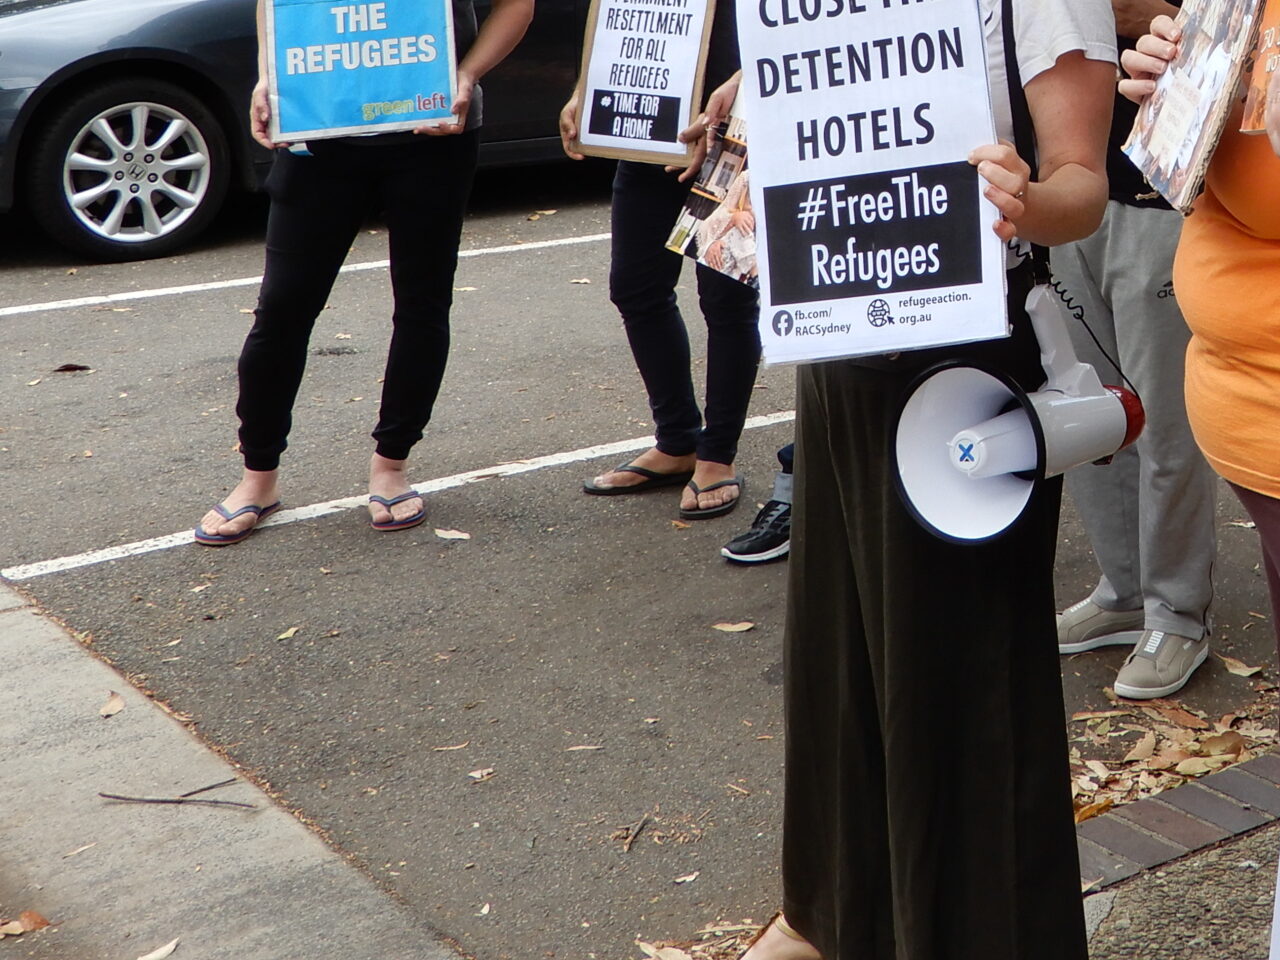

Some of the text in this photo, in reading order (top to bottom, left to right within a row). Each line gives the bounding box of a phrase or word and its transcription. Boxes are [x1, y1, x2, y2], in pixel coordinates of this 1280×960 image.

[330, 2, 387, 34] THE
[606, 7, 693, 37] RESETTLMENT
[286, 35, 438, 76] REFUGEES
[620, 36, 666, 62] FOR ALL
[757, 26, 965, 98] DETENTION
[609, 62, 670, 90] REFUGEES
[362, 93, 446, 121] green left
[640, 96, 660, 116] FOR
[612, 117, 654, 140] A HOME
[796, 102, 935, 162] HOTELS
[797, 172, 948, 231] #FreeThe
[812, 237, 940, 289] Refugees
[794, 306, 832, 321] fb.com/
[898, 291, 972, 309] refugeeaction.
[795, 321, 852, 338] RACSydney
[899, 311, 932, 326] org.au
